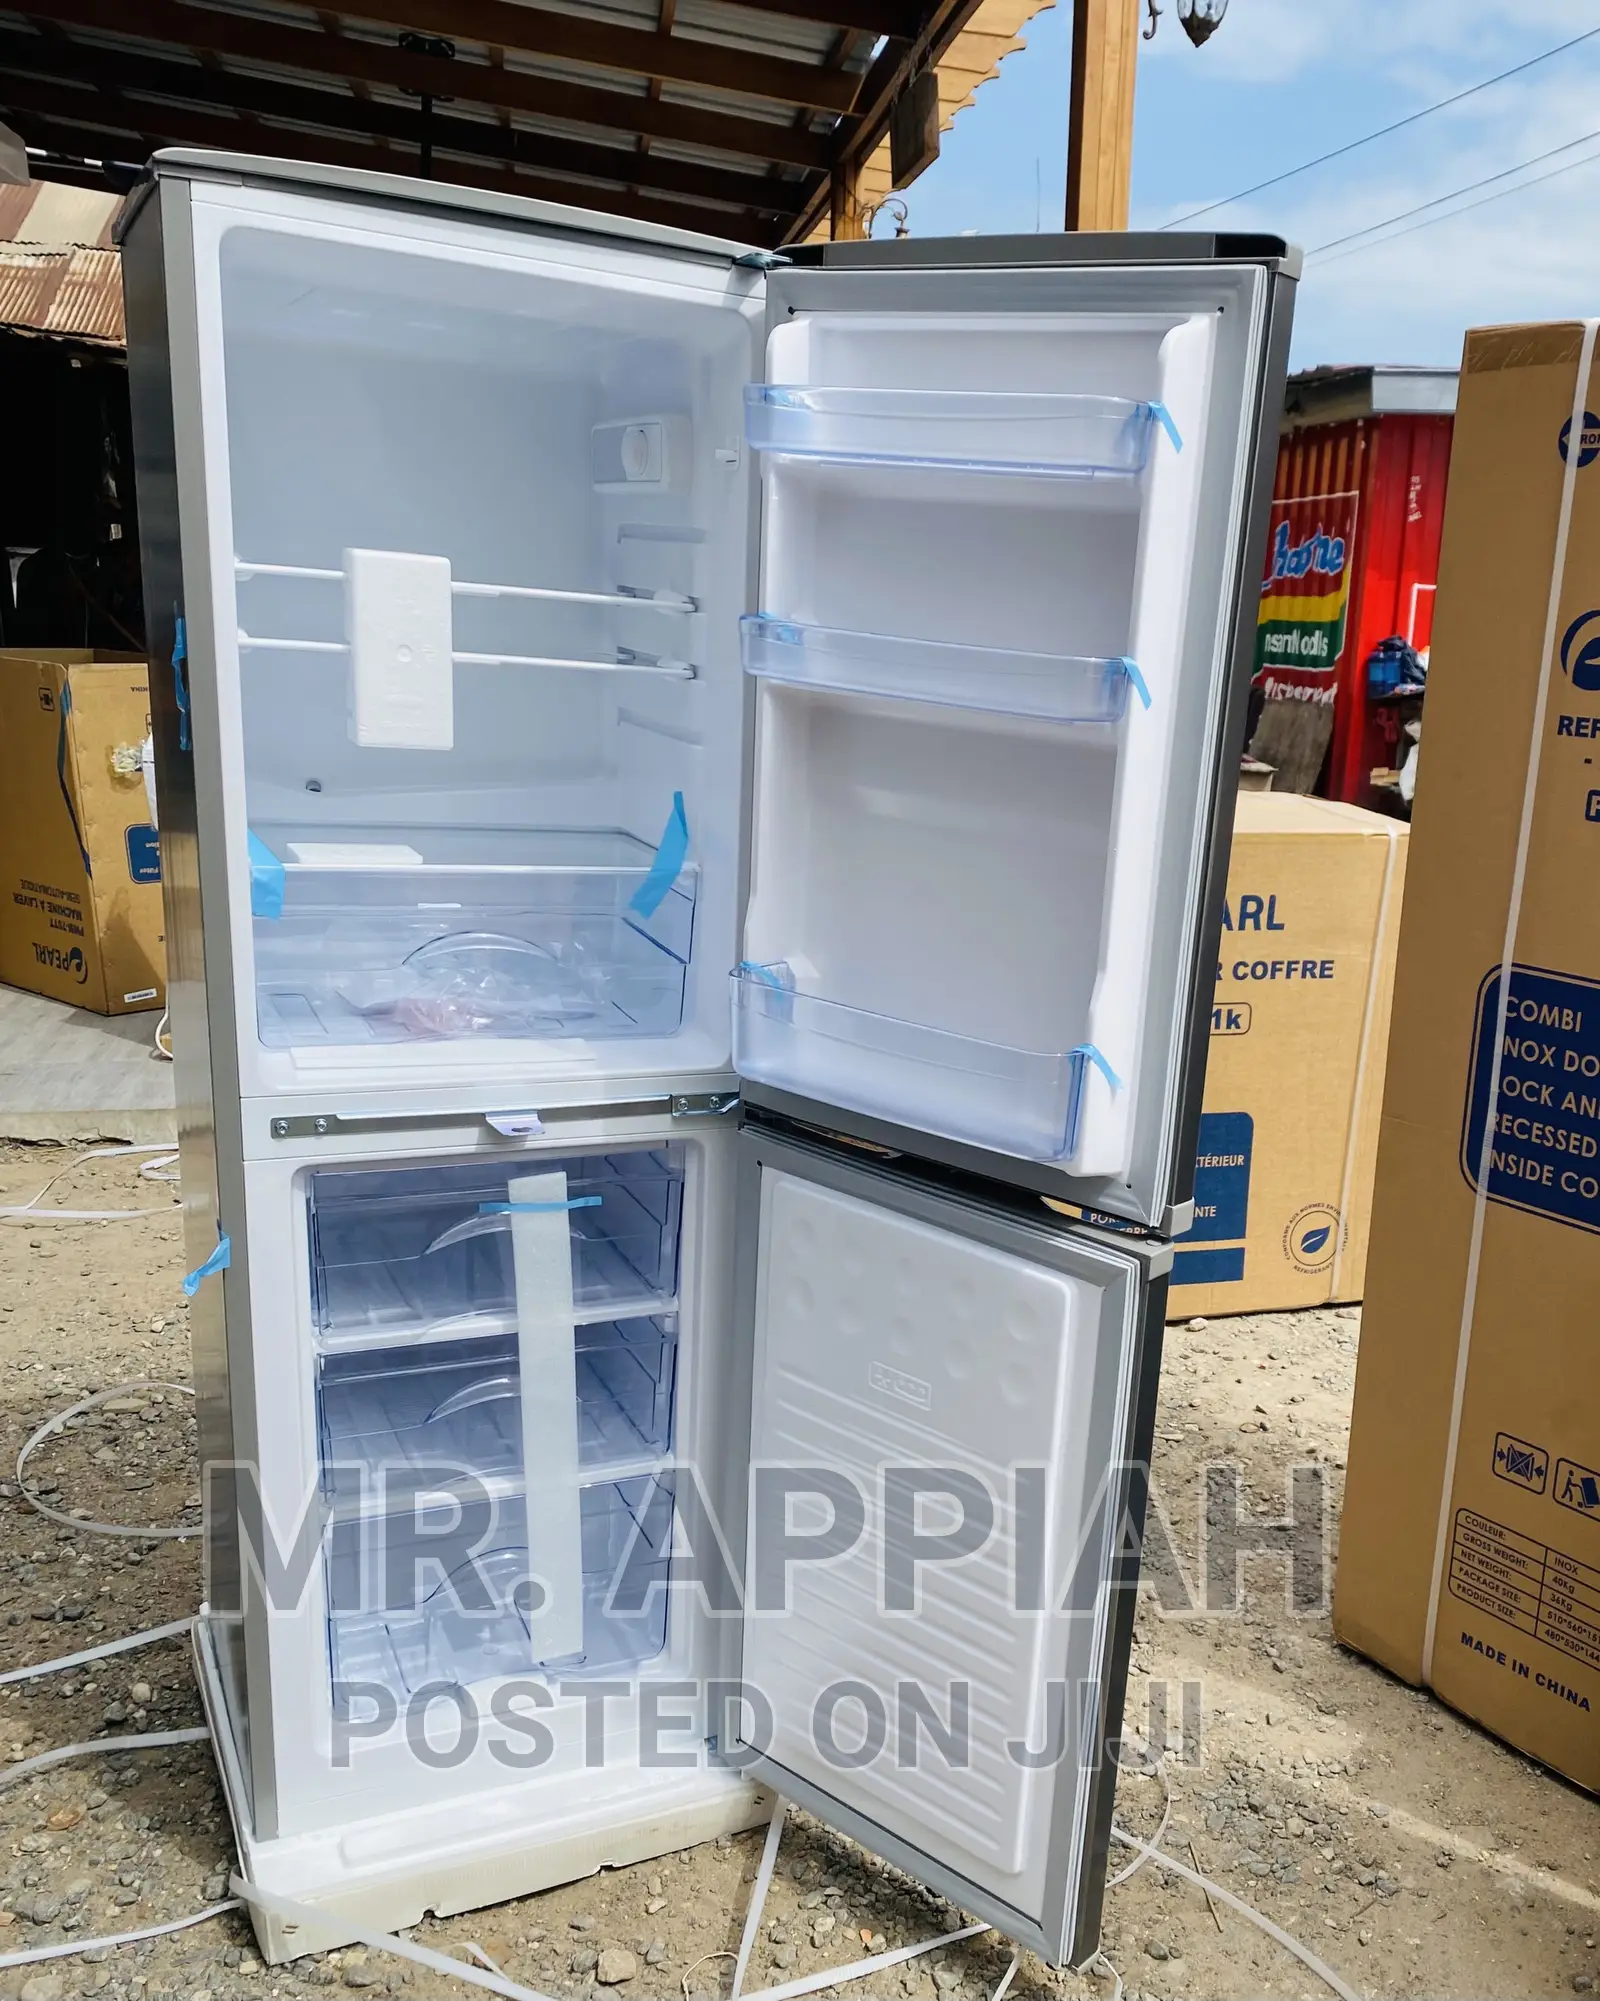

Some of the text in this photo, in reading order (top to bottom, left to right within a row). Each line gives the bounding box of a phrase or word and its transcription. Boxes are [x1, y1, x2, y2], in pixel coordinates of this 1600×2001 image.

[31, 942, 71, 972] PEARL
[1232, 960, 1335, 981] COFFRE
[1505, 995, 1583, 1033] COMBI
[1503, 1034, 1556, 1068] NOX
[1499, 1075, 1600, 1121] OCK AN
[1490, 1148, 1555, 1187] NSIDE
[1464, 1514, 1507, 1541] COULEUR:
[1460, 1549, 1512, 1581] NET WEIGHT:
[1462, 1532, 1529, 1570] GROSS WEIGHT:
[1554, 1556, 1579, 1576] INOX
[1456, 1583, 1517, 1620] PRODUCT SIZE:
[1458, 1566, 1522, 1604] PACKAGE SIZE:
[1552, 1576, 1576, 1595] 40Kg
[1460, 1631, 1591, 1713] MADE IN CHINA
